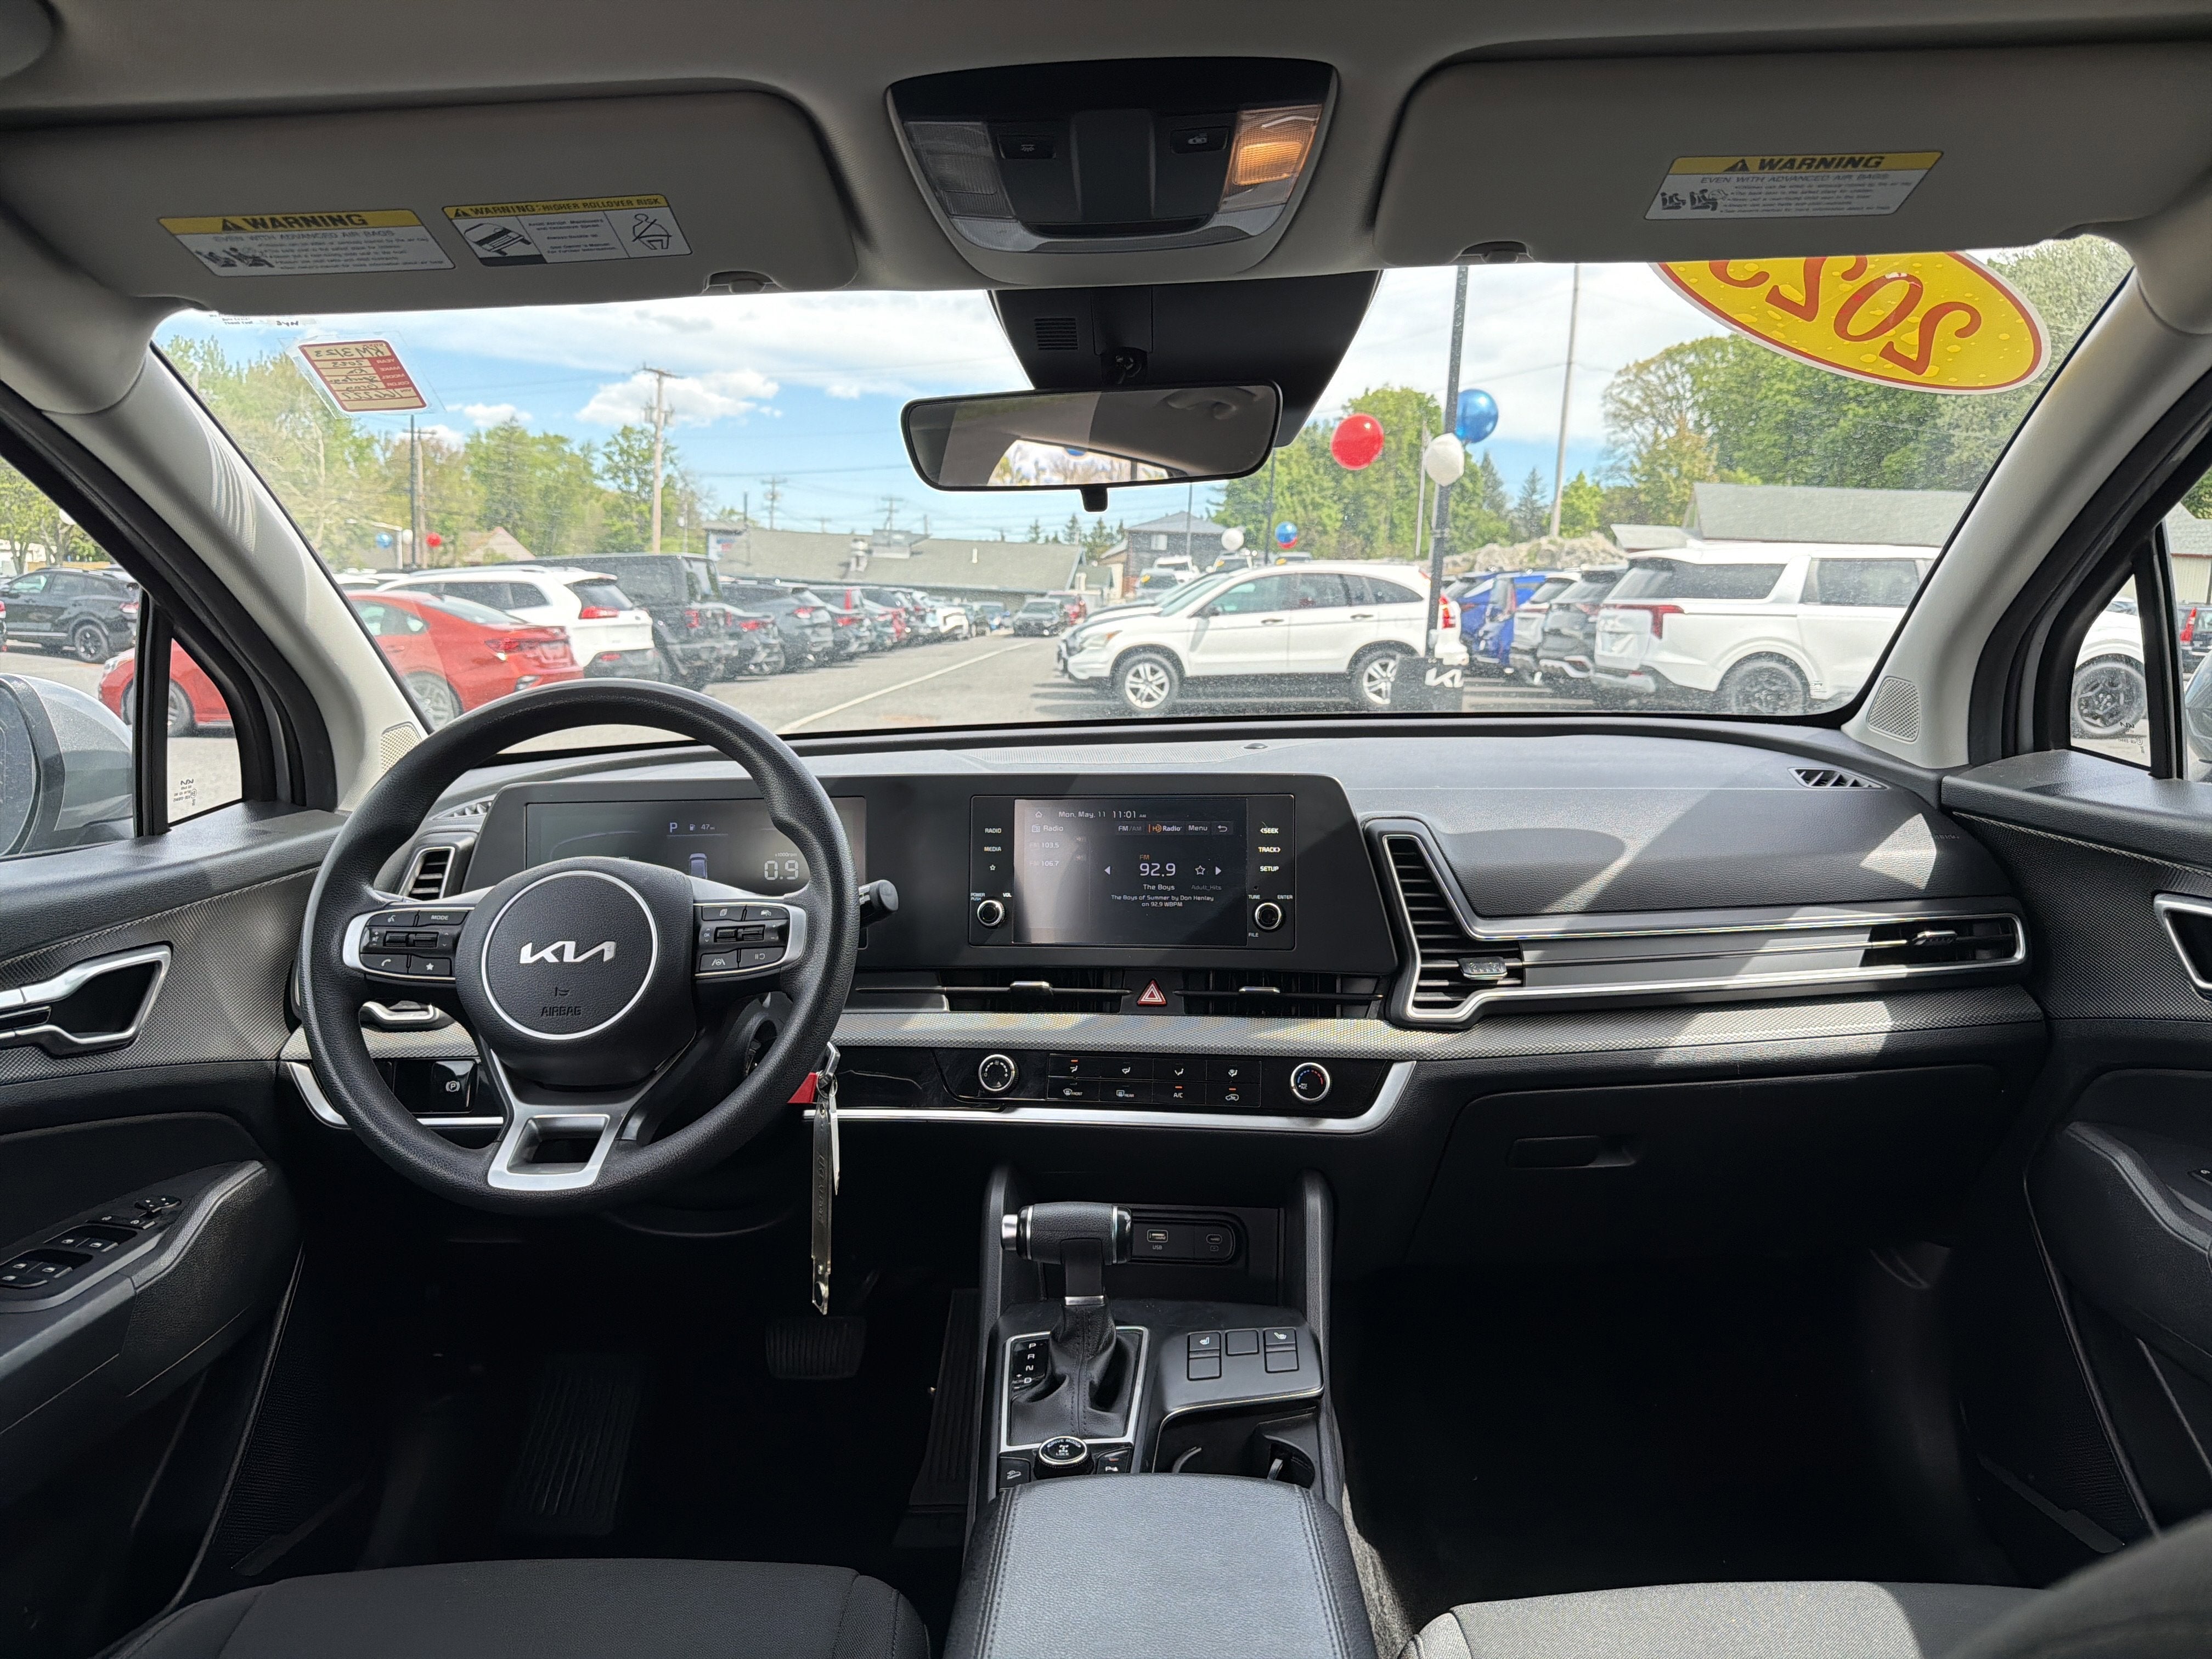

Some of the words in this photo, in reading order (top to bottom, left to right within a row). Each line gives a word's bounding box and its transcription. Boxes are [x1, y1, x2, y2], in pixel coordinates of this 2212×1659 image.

[1758, 156, 1884, 171] WARNING
[543, 202, 579, 212] HIGHER
[583, 200, 633, 209] ROLLOVER
[243, 213, 368, 230] WARNING
[279, 231, 337, 240] ADVANCED
[364, 229, 394, 238] BAGS
[1113, 810, 1136, 819] 11:01
[669, 822, 678, 833] P
[764, 860, 799, 881] 0.9
[1139, 863, 1176, 877] 92.9
[519, 940, 617, 964] KIA
[540, 1006, 582, 1017] AIRBAG
